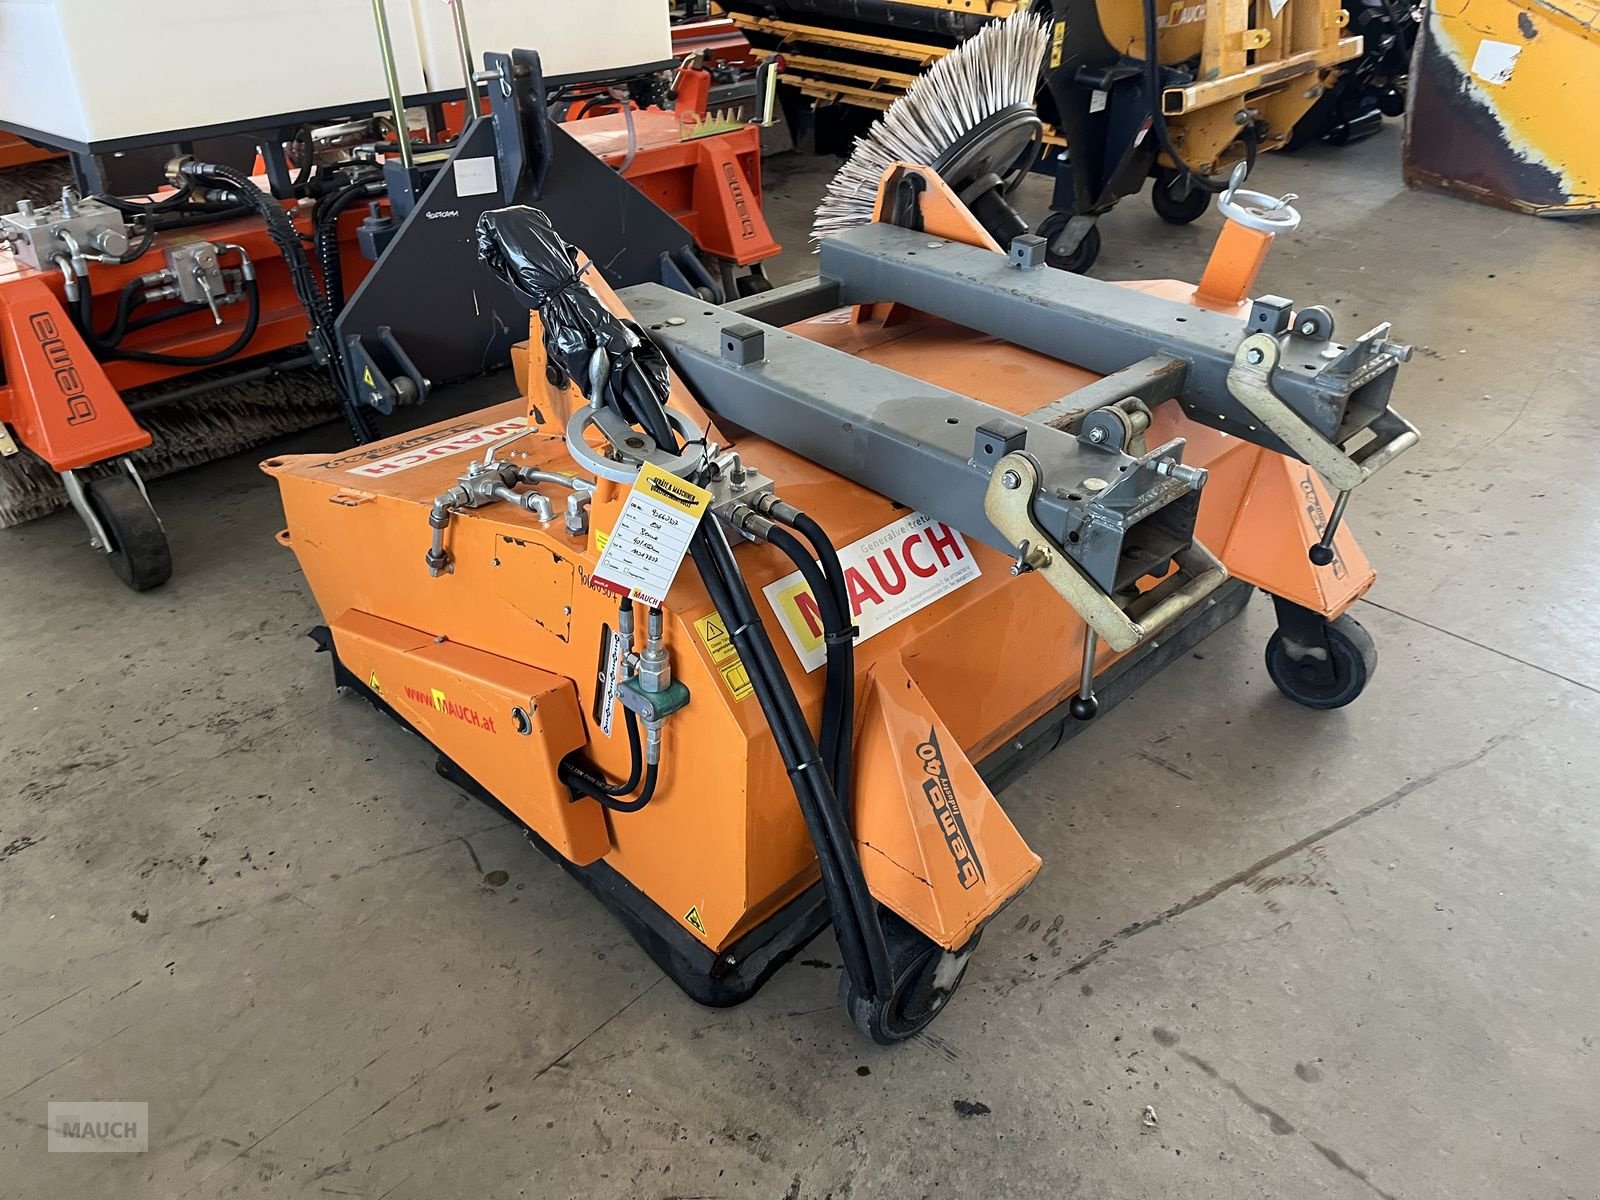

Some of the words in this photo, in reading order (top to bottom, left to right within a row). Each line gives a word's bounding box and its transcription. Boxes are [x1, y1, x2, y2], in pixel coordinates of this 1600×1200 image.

[722, 162, 756, 240] bema
[29, 311, 97, 427] bema
[361, 423, 527, 474] MAUCH
[633, 590, 659, 606] MAUCH
[404, 686, 497, 735] www.MAUCH.at
[915, 742, 942, 777] 40
[940, 777, 960, 816] Industry
[922, 777, 979, 891] bema
